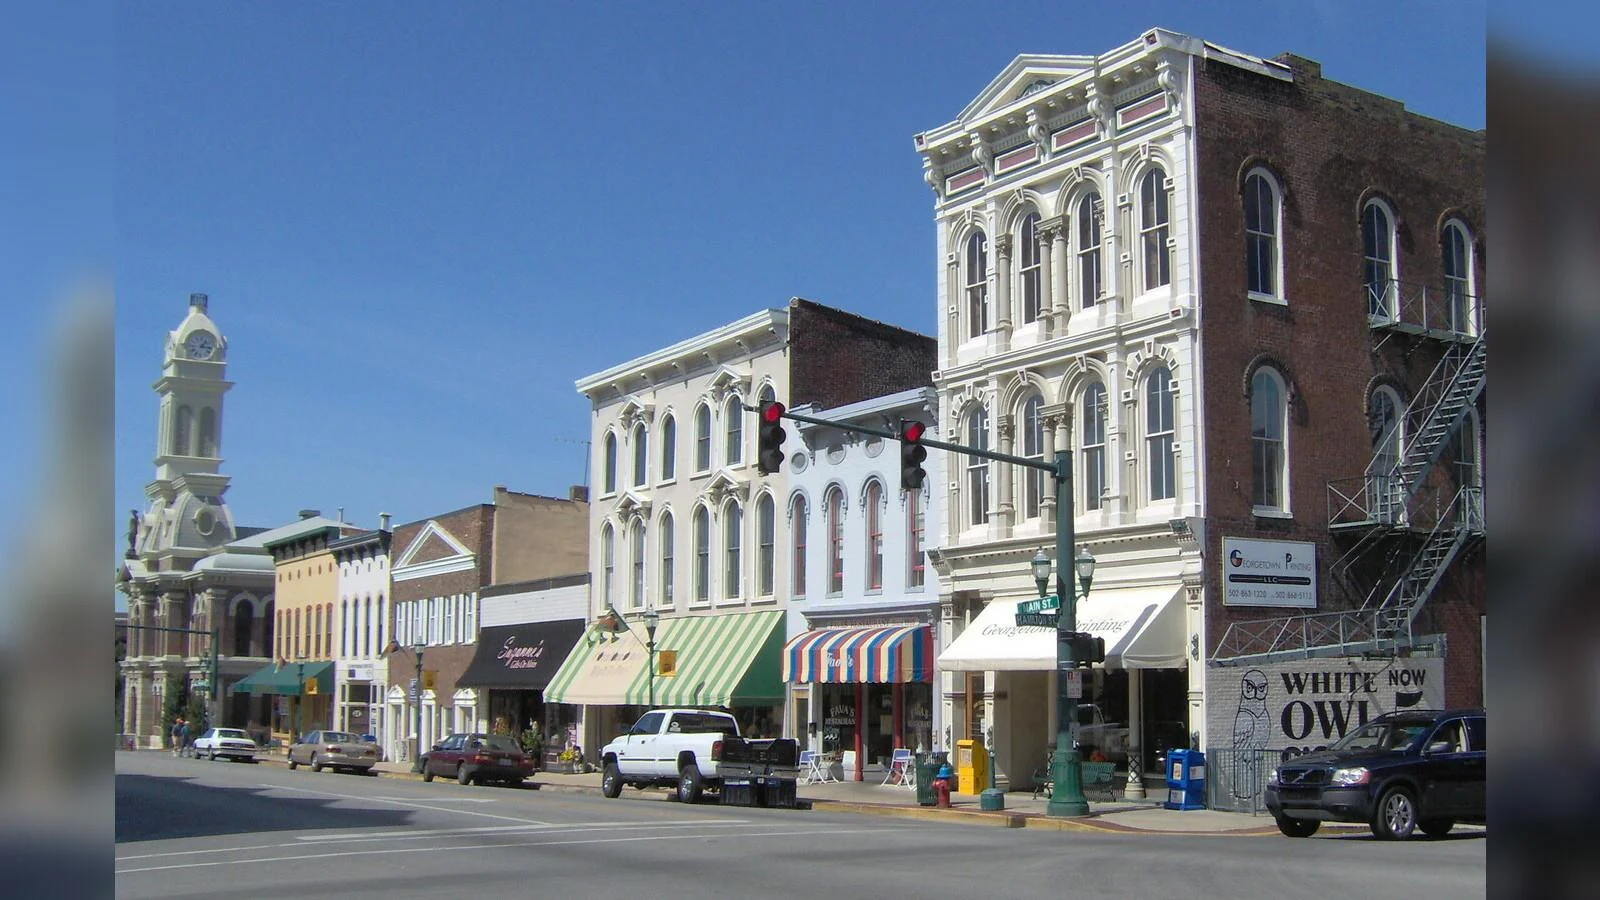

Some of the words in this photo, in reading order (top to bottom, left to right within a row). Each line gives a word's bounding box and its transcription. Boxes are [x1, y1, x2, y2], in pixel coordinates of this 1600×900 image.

[1230, 549, 1280, 569] GEORGETOWN
[1285, 552, 1312, 572] PRINTING
[1022, 601, 1040, 612] MAIN
[1041, 599, 1054, 609] ST.
[1016, 615, 1047, 625] HAMILTON
[497, 636, 544, 667] Suzanne's
[1281, 671, 1378, 695] WHITE
[1388, 669, 1426, 686] NOW
